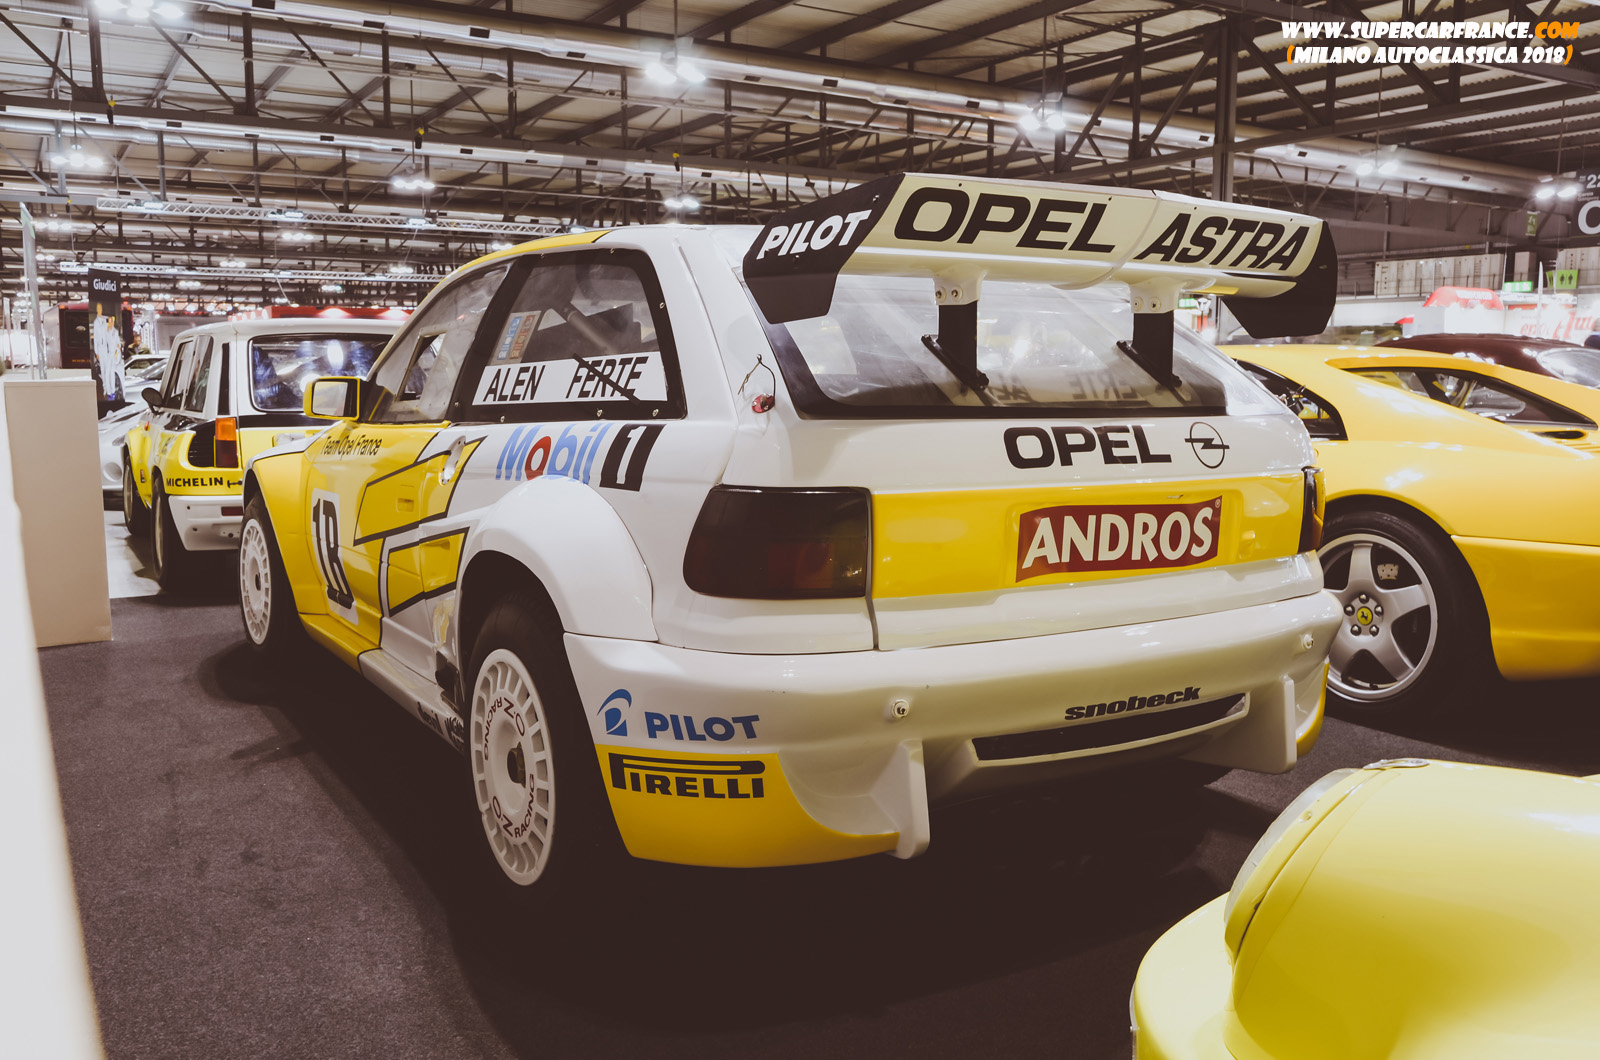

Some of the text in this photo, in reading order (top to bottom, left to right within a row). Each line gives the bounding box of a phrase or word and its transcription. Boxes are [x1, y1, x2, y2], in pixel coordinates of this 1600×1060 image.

[757, 210, 872, 260] PILOT
[894, 186, 1310, 272] OPEL ASTRA
[93, 278, 117, 292] Giudici
[483, 355, 649, 402] ALEN FERTE
[320, 434, 382, 460] Team Opel France
[496, 422, 613, 485] Mobil
[1003, 425, 1171, 469] OPEL
[166, 477, 224, 488] MICHELIN
[1022, 506, 1213, 569] ANDROS
[644, 711, 760, 741] PILOT
[1064, 686, 1200, 720] snobeck
[608, 753, 766, 799] PIRELLI
[514, 773, 535, 839] RACING
